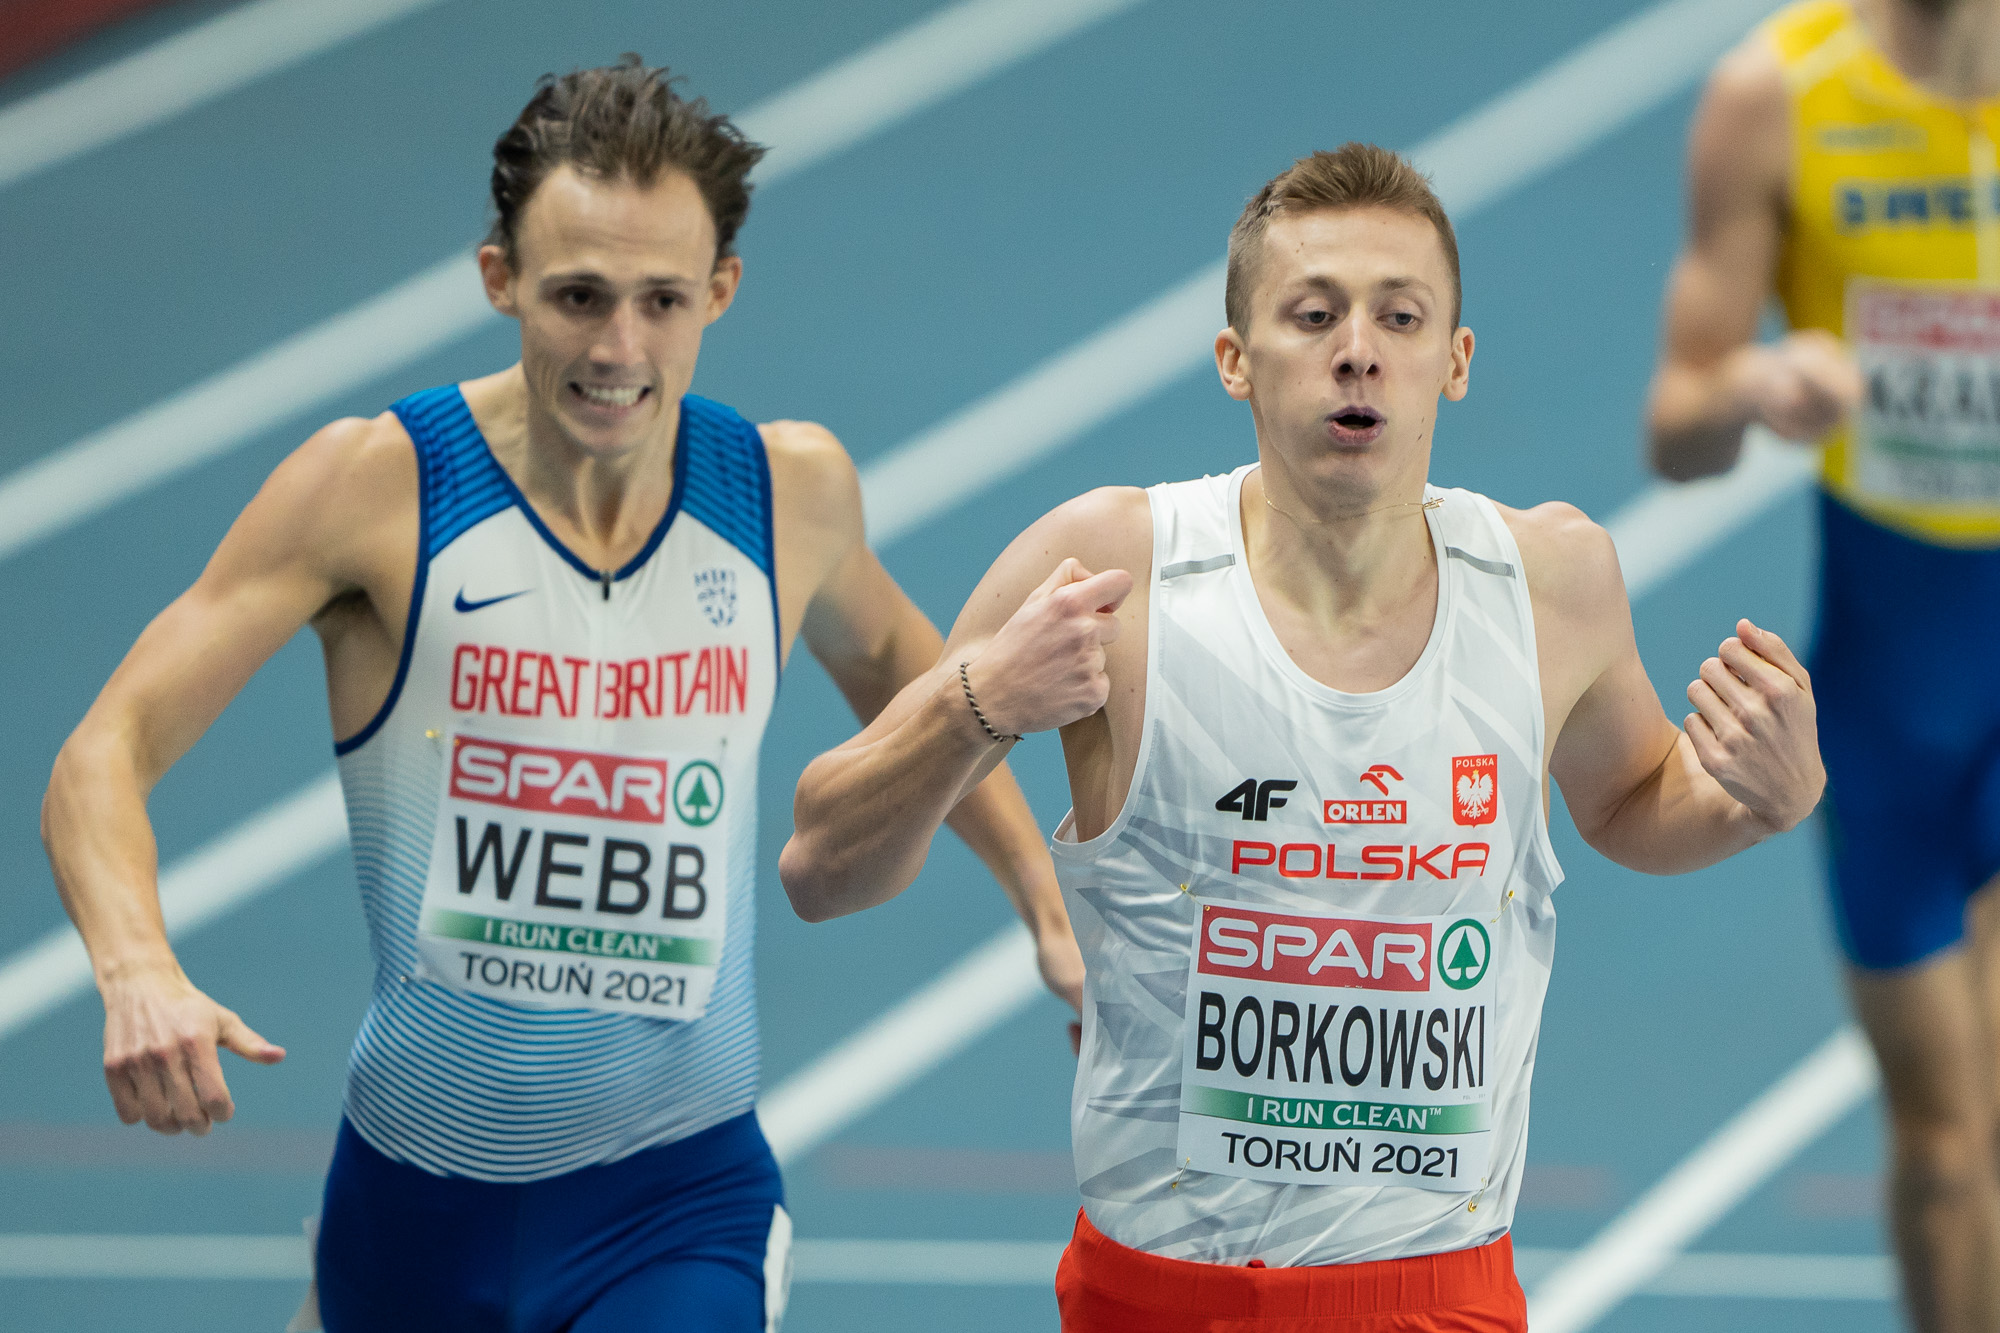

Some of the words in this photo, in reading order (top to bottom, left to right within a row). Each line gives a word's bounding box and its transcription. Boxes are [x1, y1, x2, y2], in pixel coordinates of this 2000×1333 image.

[450, 643, 590, 719] GREAT
[595, 646, 748, 720] BRITAIN
[456, 744, 663, 816] SPAR
[1455, 757, 1495, 769] POLSKA
[1215, 778, 1298, 821] 4F
[1328, 802, 1402, 822] ORLEN
[455, 816, 707, 921] WEBB
[1231, 840, 1491, 881] POLSKA
[484, 919, 493, 941] I
[500, 920, 561, 949] RUN
[1206, 916, 1426, 982] SPAR
[459, 952, 593, 997] TORUŃ
[603, 969, 688, 1006] 2021
[1196, 990, 1486, 1091] BORKOWSKI
[1247, 1097, 1254, 1118] I
[1262, 1099, 1324, 1125] RUN
[1221, 1131, 1361, 1173] TORUŃ
[1371, 1143, 1459, 1178] 2021
